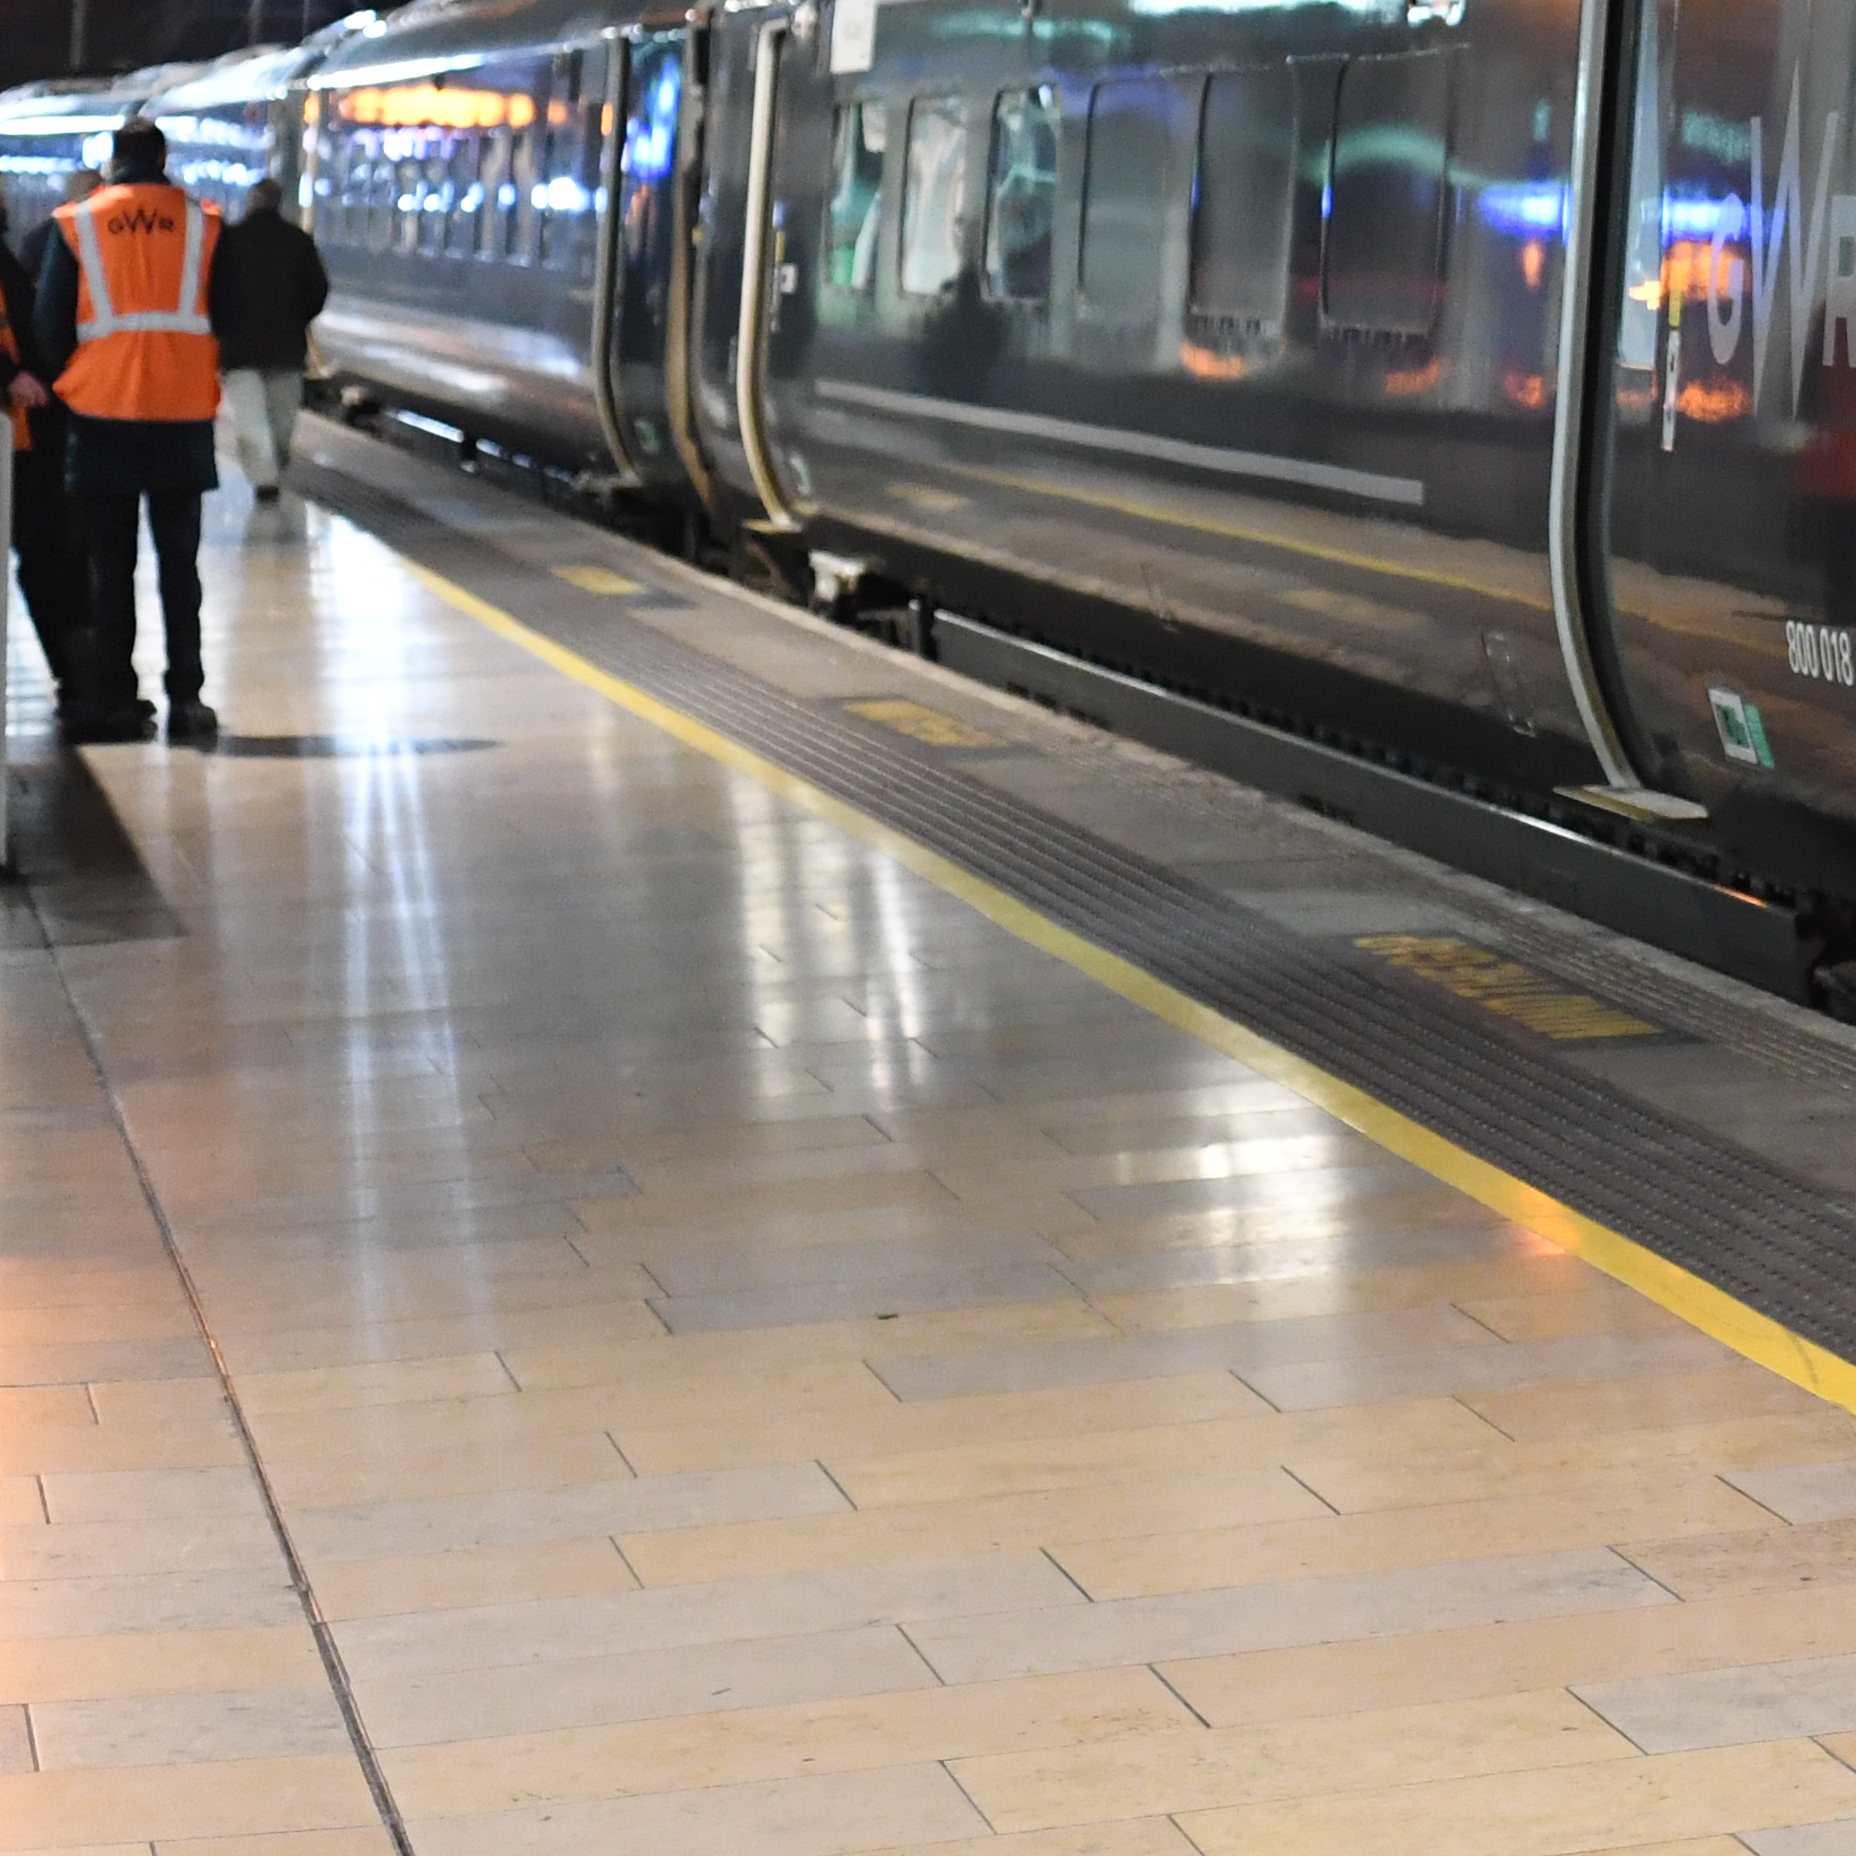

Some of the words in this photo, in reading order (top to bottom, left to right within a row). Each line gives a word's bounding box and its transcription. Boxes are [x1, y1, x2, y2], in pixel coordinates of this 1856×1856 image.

[107, 207, 176, 238] GWR
[1786, 620, 1819, 679] 800
[1820, 627, 1854, 686] 018
